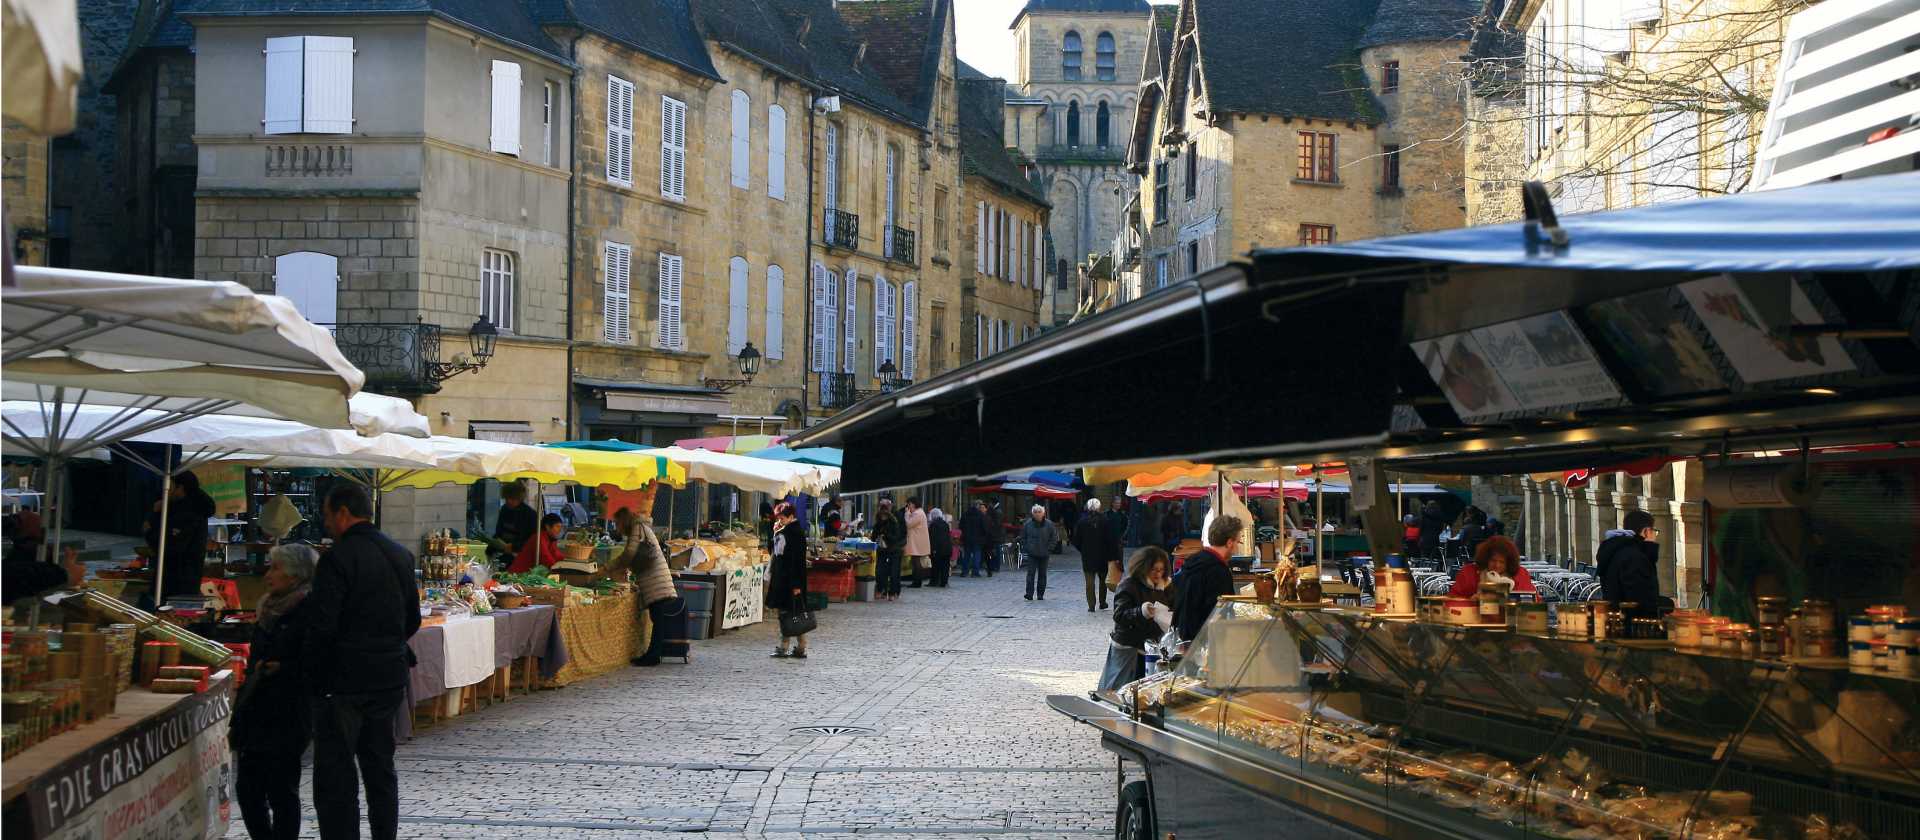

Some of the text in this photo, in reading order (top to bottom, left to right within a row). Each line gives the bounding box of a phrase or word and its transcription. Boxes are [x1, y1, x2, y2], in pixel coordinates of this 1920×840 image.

[46, 764, 92, 828] FOIE
[100, 737, 143, 793] GRAS
[145, 714, 192, 758] NICOLE
